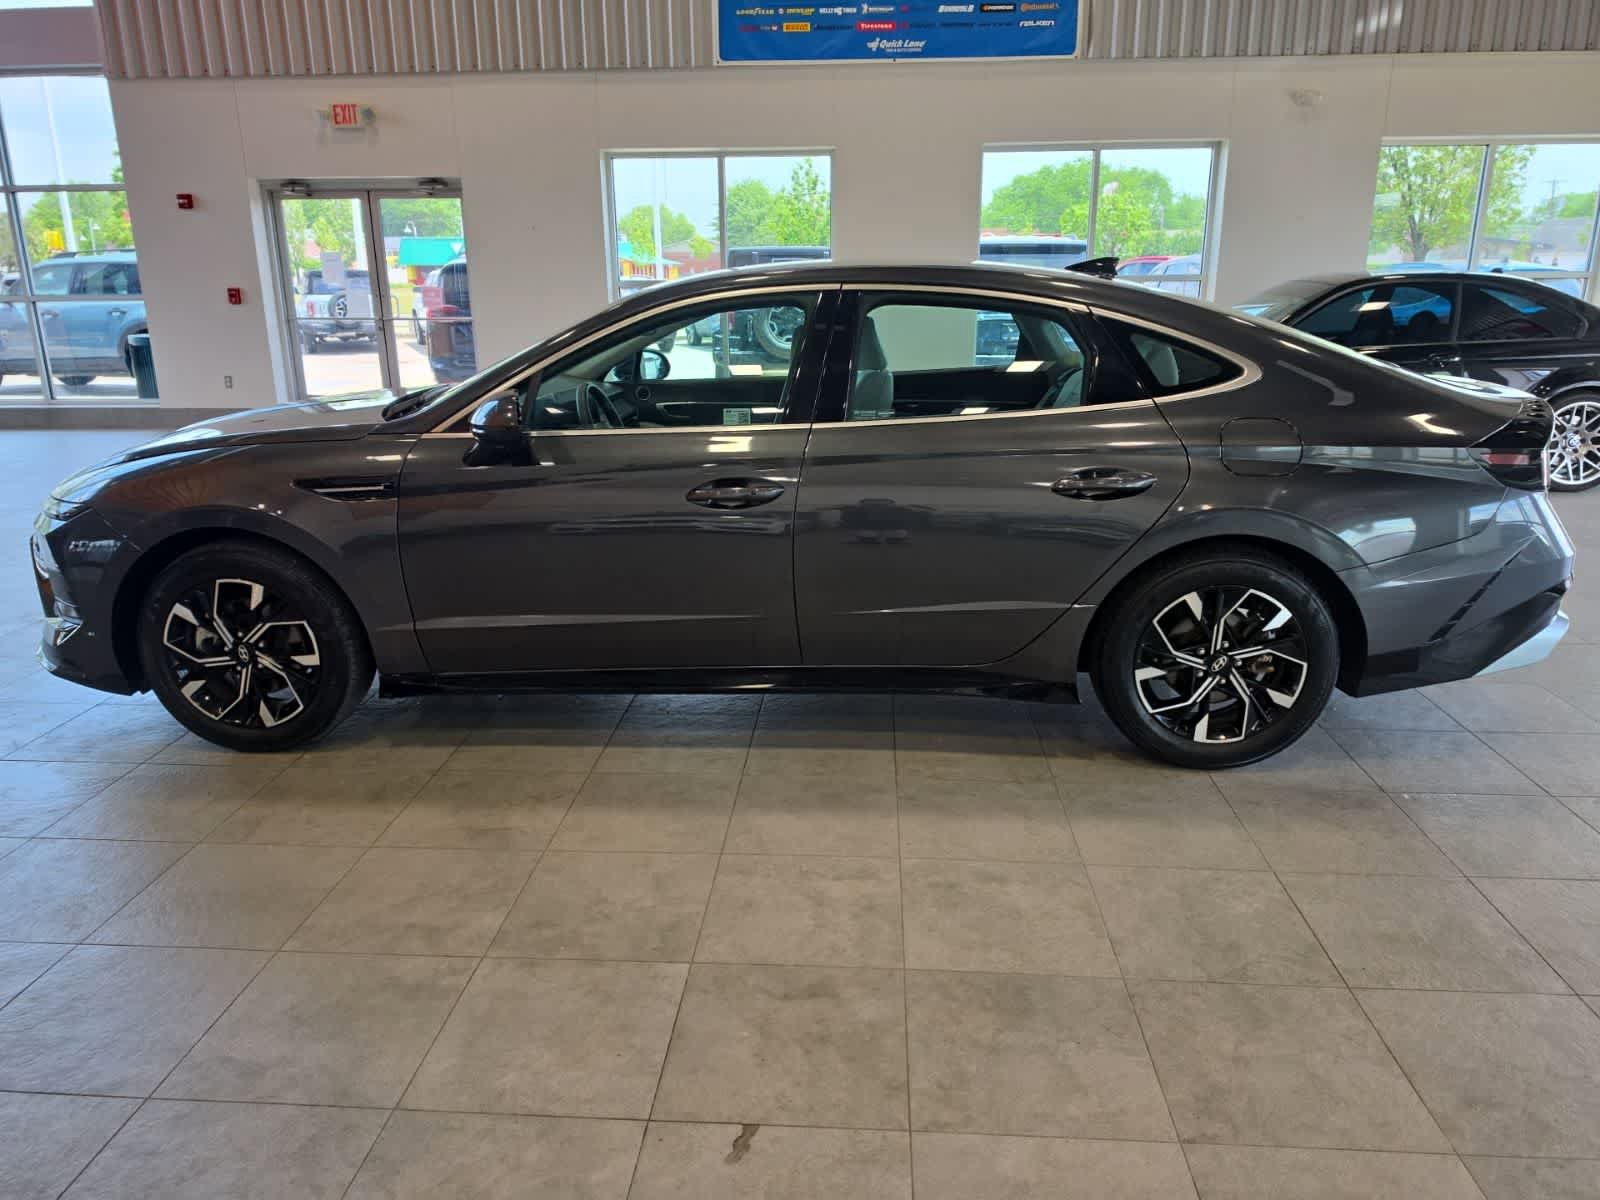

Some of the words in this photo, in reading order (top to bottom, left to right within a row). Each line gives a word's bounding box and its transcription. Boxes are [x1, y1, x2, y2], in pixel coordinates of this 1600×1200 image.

[880, 39, 902, 48] Quick
[904, 40, 926, 48] Lane
[333, 104, 357, 124] EXIT
